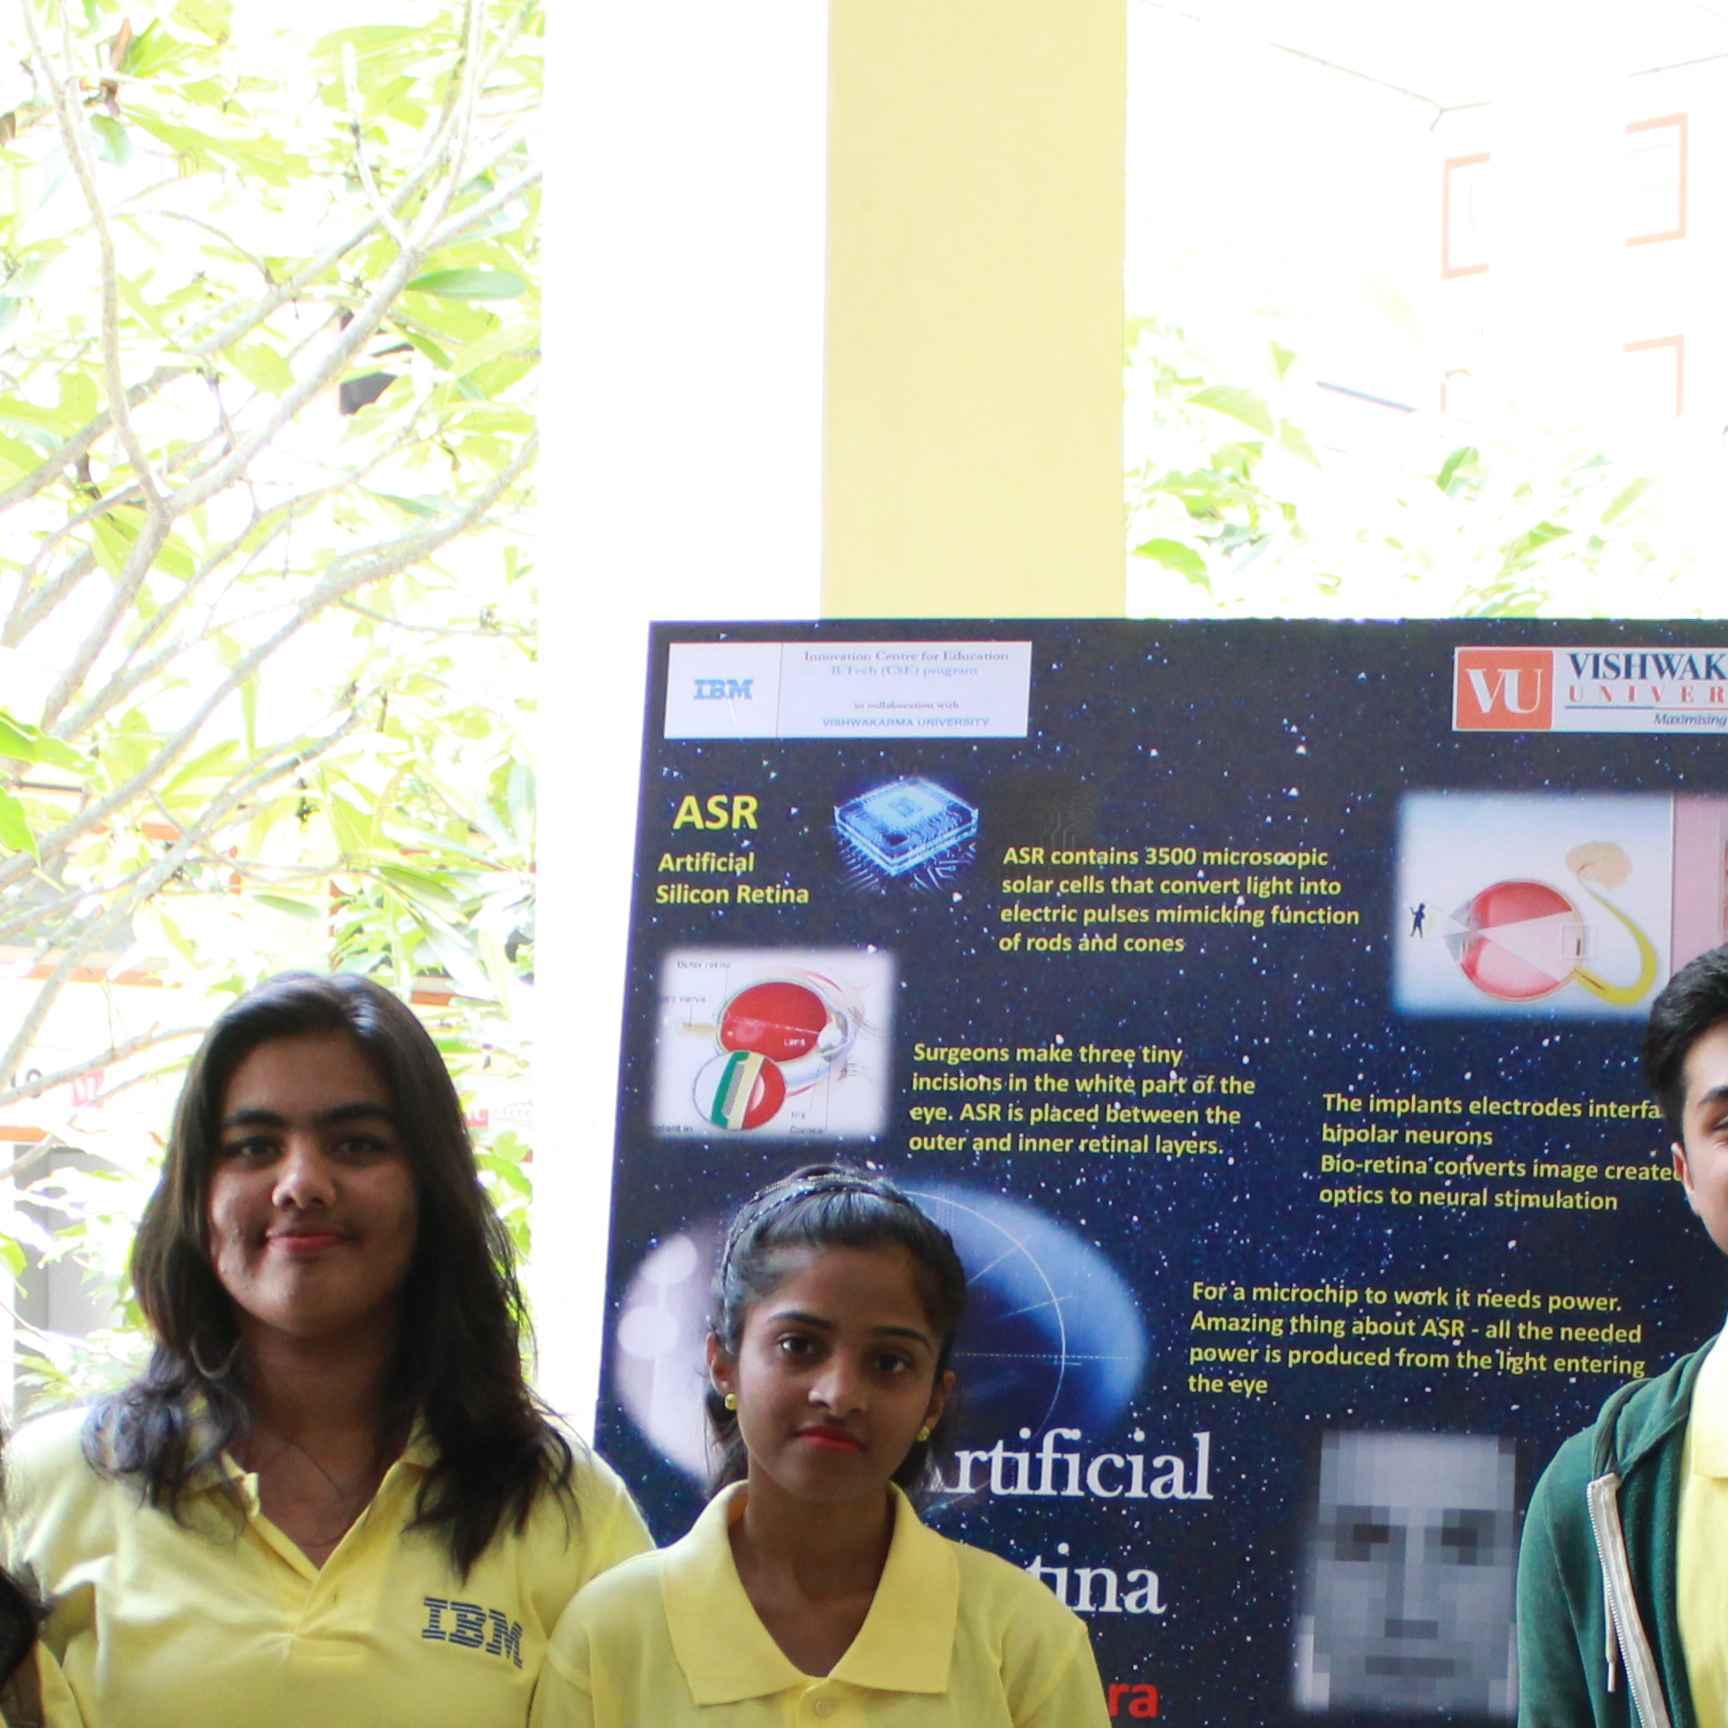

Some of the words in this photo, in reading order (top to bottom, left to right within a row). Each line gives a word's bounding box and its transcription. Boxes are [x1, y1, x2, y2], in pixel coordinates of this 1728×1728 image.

[694, 679, 754, 700] IBM
[1464, 667, 1544, 714] VU
[673, 795, 759, 831] ASR
[658, 851, 755, 874] Artificial
[1003, 846, 1044, 866] ASR
[1050, 846, 1138, 867] contains
[1144, 847, 1197, 867] 3500
[1202, 847, 1329, 873] microscopic
[655, 883, 730, 906] Silicon
[735, 883, 810, 906] Retina
[1002, 875, 1054, 895] solar
[1059, 875, 1105, 896] cells
[1111, 876, 1155, 896] that
[1160, 877, 1241, 896] convert
[1246, 876, 1293, 901] light
[1300, 877, 1342, 896] into
[1000, 904, 1076, 924] electric
[1083, 905, 1149, 930] pulses
[1155, 905, 1265, 930] mimicking
[1271, 905, 1361, 926] function
[998, 933, 1022, 953] of
[1026, 932, 1072, 953] rods
[1079, 932, 1118, 953] and
[1123, 937, 1186, 953] cones
[913, 1043, 1010, 1066] Surgeons
[1015, 1043, 1073, 1064] make
[1078, 1044, 1137, 1065] three
[1141, 1045, 1184, 1068] tiny
[911, 1073, 1003, 1092] incisions
[1008, 1073, 1028, 1092] in
[1033, 1074, 1069, 1092] the
[1075, 1075, 1136, 1093] white
[1141, 1076, 1187, 1098] part
[1192, 1075, 1214, 1095] of
[1219, 1076, 1256, 1095] the
[910, 1106, 954, 1127] eye.
[959, 1103, 1002, 1122] ASR
[1007, 1104, 1025, 1122] is
[1030, 1105, 1100, 1127] placed
[1105, 1105, 1200, 1124] between
[1206, 1106, 1241, 1126] the
[1323, 1093, 1362, 1112] The
[1369, 1094, 1463, 1118] implants
[1468, 1096, 1582, 1118] electrodes
[908, 1134, 967, 1152] outer
[972, 1132, 1013, 1153] and
[1017, 1133, 1074, 1153] inner
[1079, 1133, 1149, 1154] retinal
[1154, 1134, 1224, 1158] layers.
[1321, 1123, 1398, 1146] bipolar
[1404, 1129, 1494, 1147] neurons
[1320, 1153, 1428, 1175] Bio-retina
[1433, 1158, 1527, 1178] converts
[1532, 1159, 1598, 1183] image
[1318, 1185, 1384, 1208] optics
[1390, 1187, 1413, 1205] to
[1418, 1186, 1488, 1207] neural
[1493, 1187, 1619, 1212] stimulation
[1192, 1281, 1225, 1302] For
[1232, 1287, 1246, 1302] a
[1252, 1283, 1358, 1308] microchip
[1365, 1287, 1388, 1305] to
[1394, 1286, 1449, 1306] work
[1455, 1287, 1471, 1307] it
[1476, 1288, 1542, 1310] needs
[1548, 1293, 1622, 1315] power.
[1190, 1313, 1284, 1336] Amazing
[1289, 1313, 1346, 1339] thing
[1351, 1316, 1417, 1337] about
[1421, 1318, 1466, 1338] ASR
[1485, 1319, 1512, 1339] all
[1517, 1321, 1553, 1341] the
[1560, 1323, 1643, 1344] needed
[1189, 1346, 1259, 1368] power
[1264, 1345, 1282, 1364] is
[1287, 1346, 1391, 1372] produced
[1397, 1348, 1450, 1369] from
[1456, 1350, 1493, 1370] the
[1499, 1350, 1548, 1376] light
[1553, 1355, 1647, 1379] entering
[1187, 1374, 1223, 1394] the
[1229, 1377, 1268, 1398] eye
[944, 1426, 1214, 1501] rtificial
[422, 1596, 523, 1669] IBM
